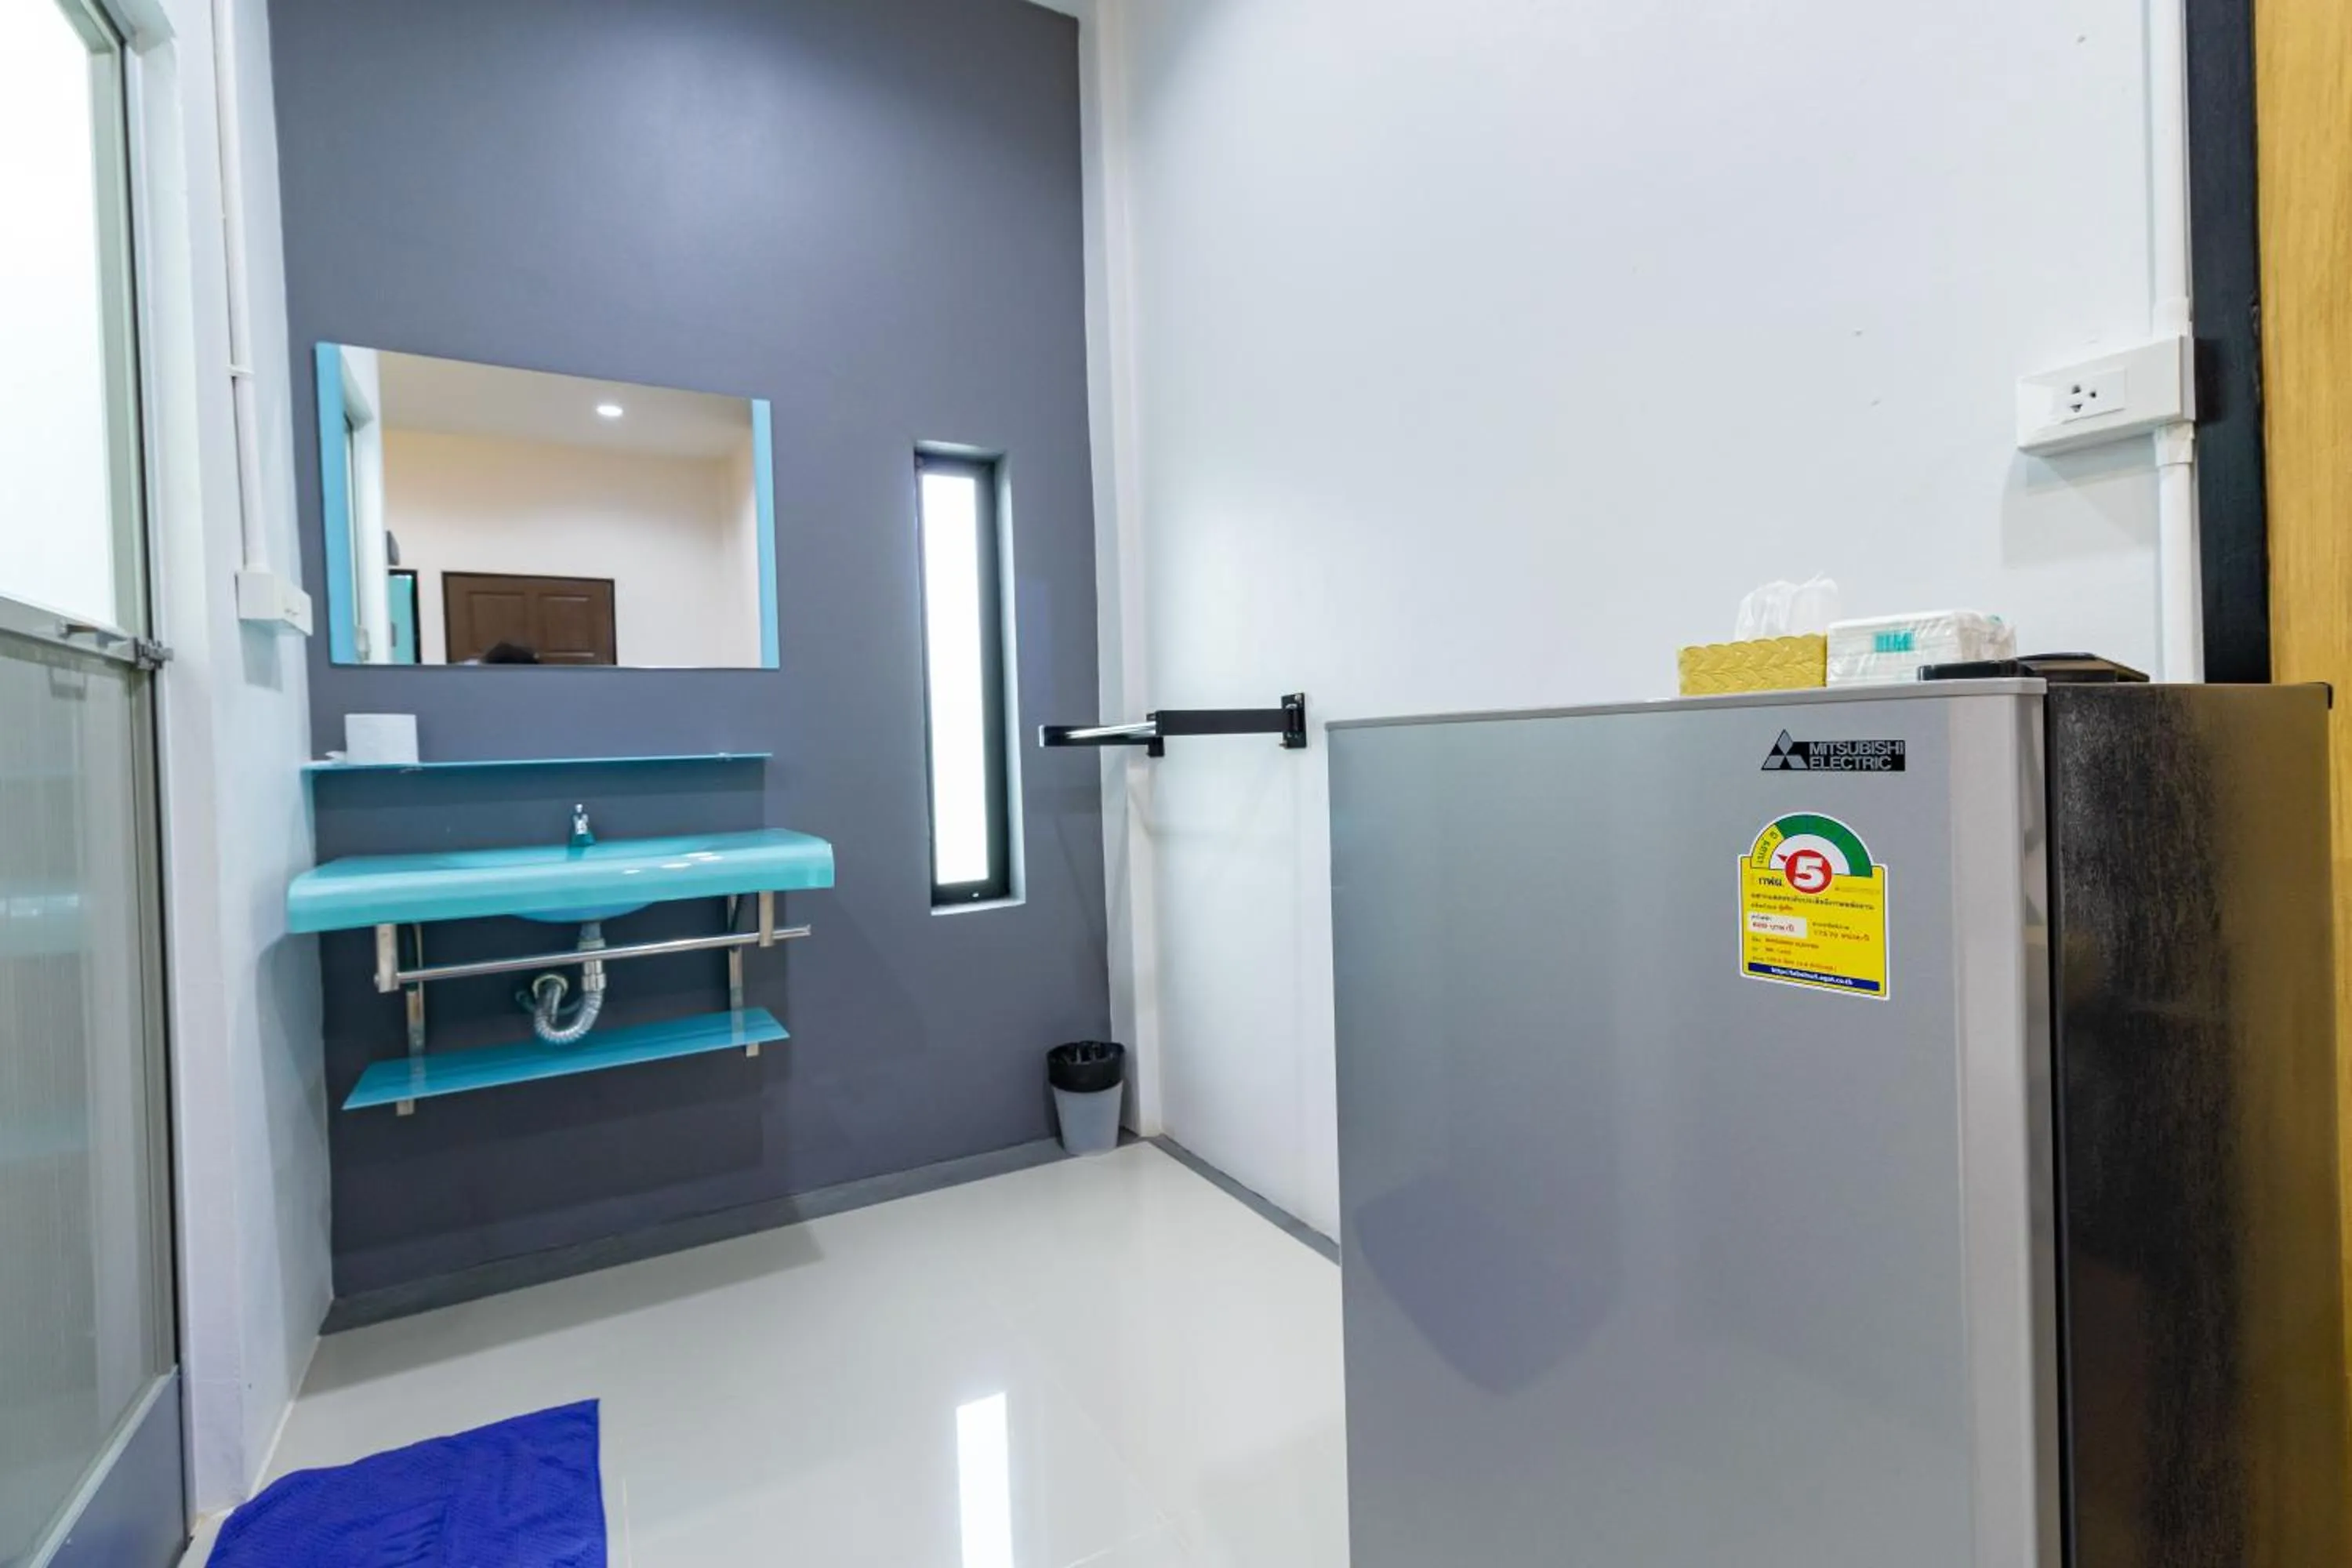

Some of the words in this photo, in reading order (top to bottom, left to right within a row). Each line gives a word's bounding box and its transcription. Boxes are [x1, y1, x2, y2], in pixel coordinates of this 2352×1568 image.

[1809, 741, 1904, 756] MITSUBISHI
[1809, 755, 1892, 770] ELECTRIC
[1793, 855, 1825, 890] 5
